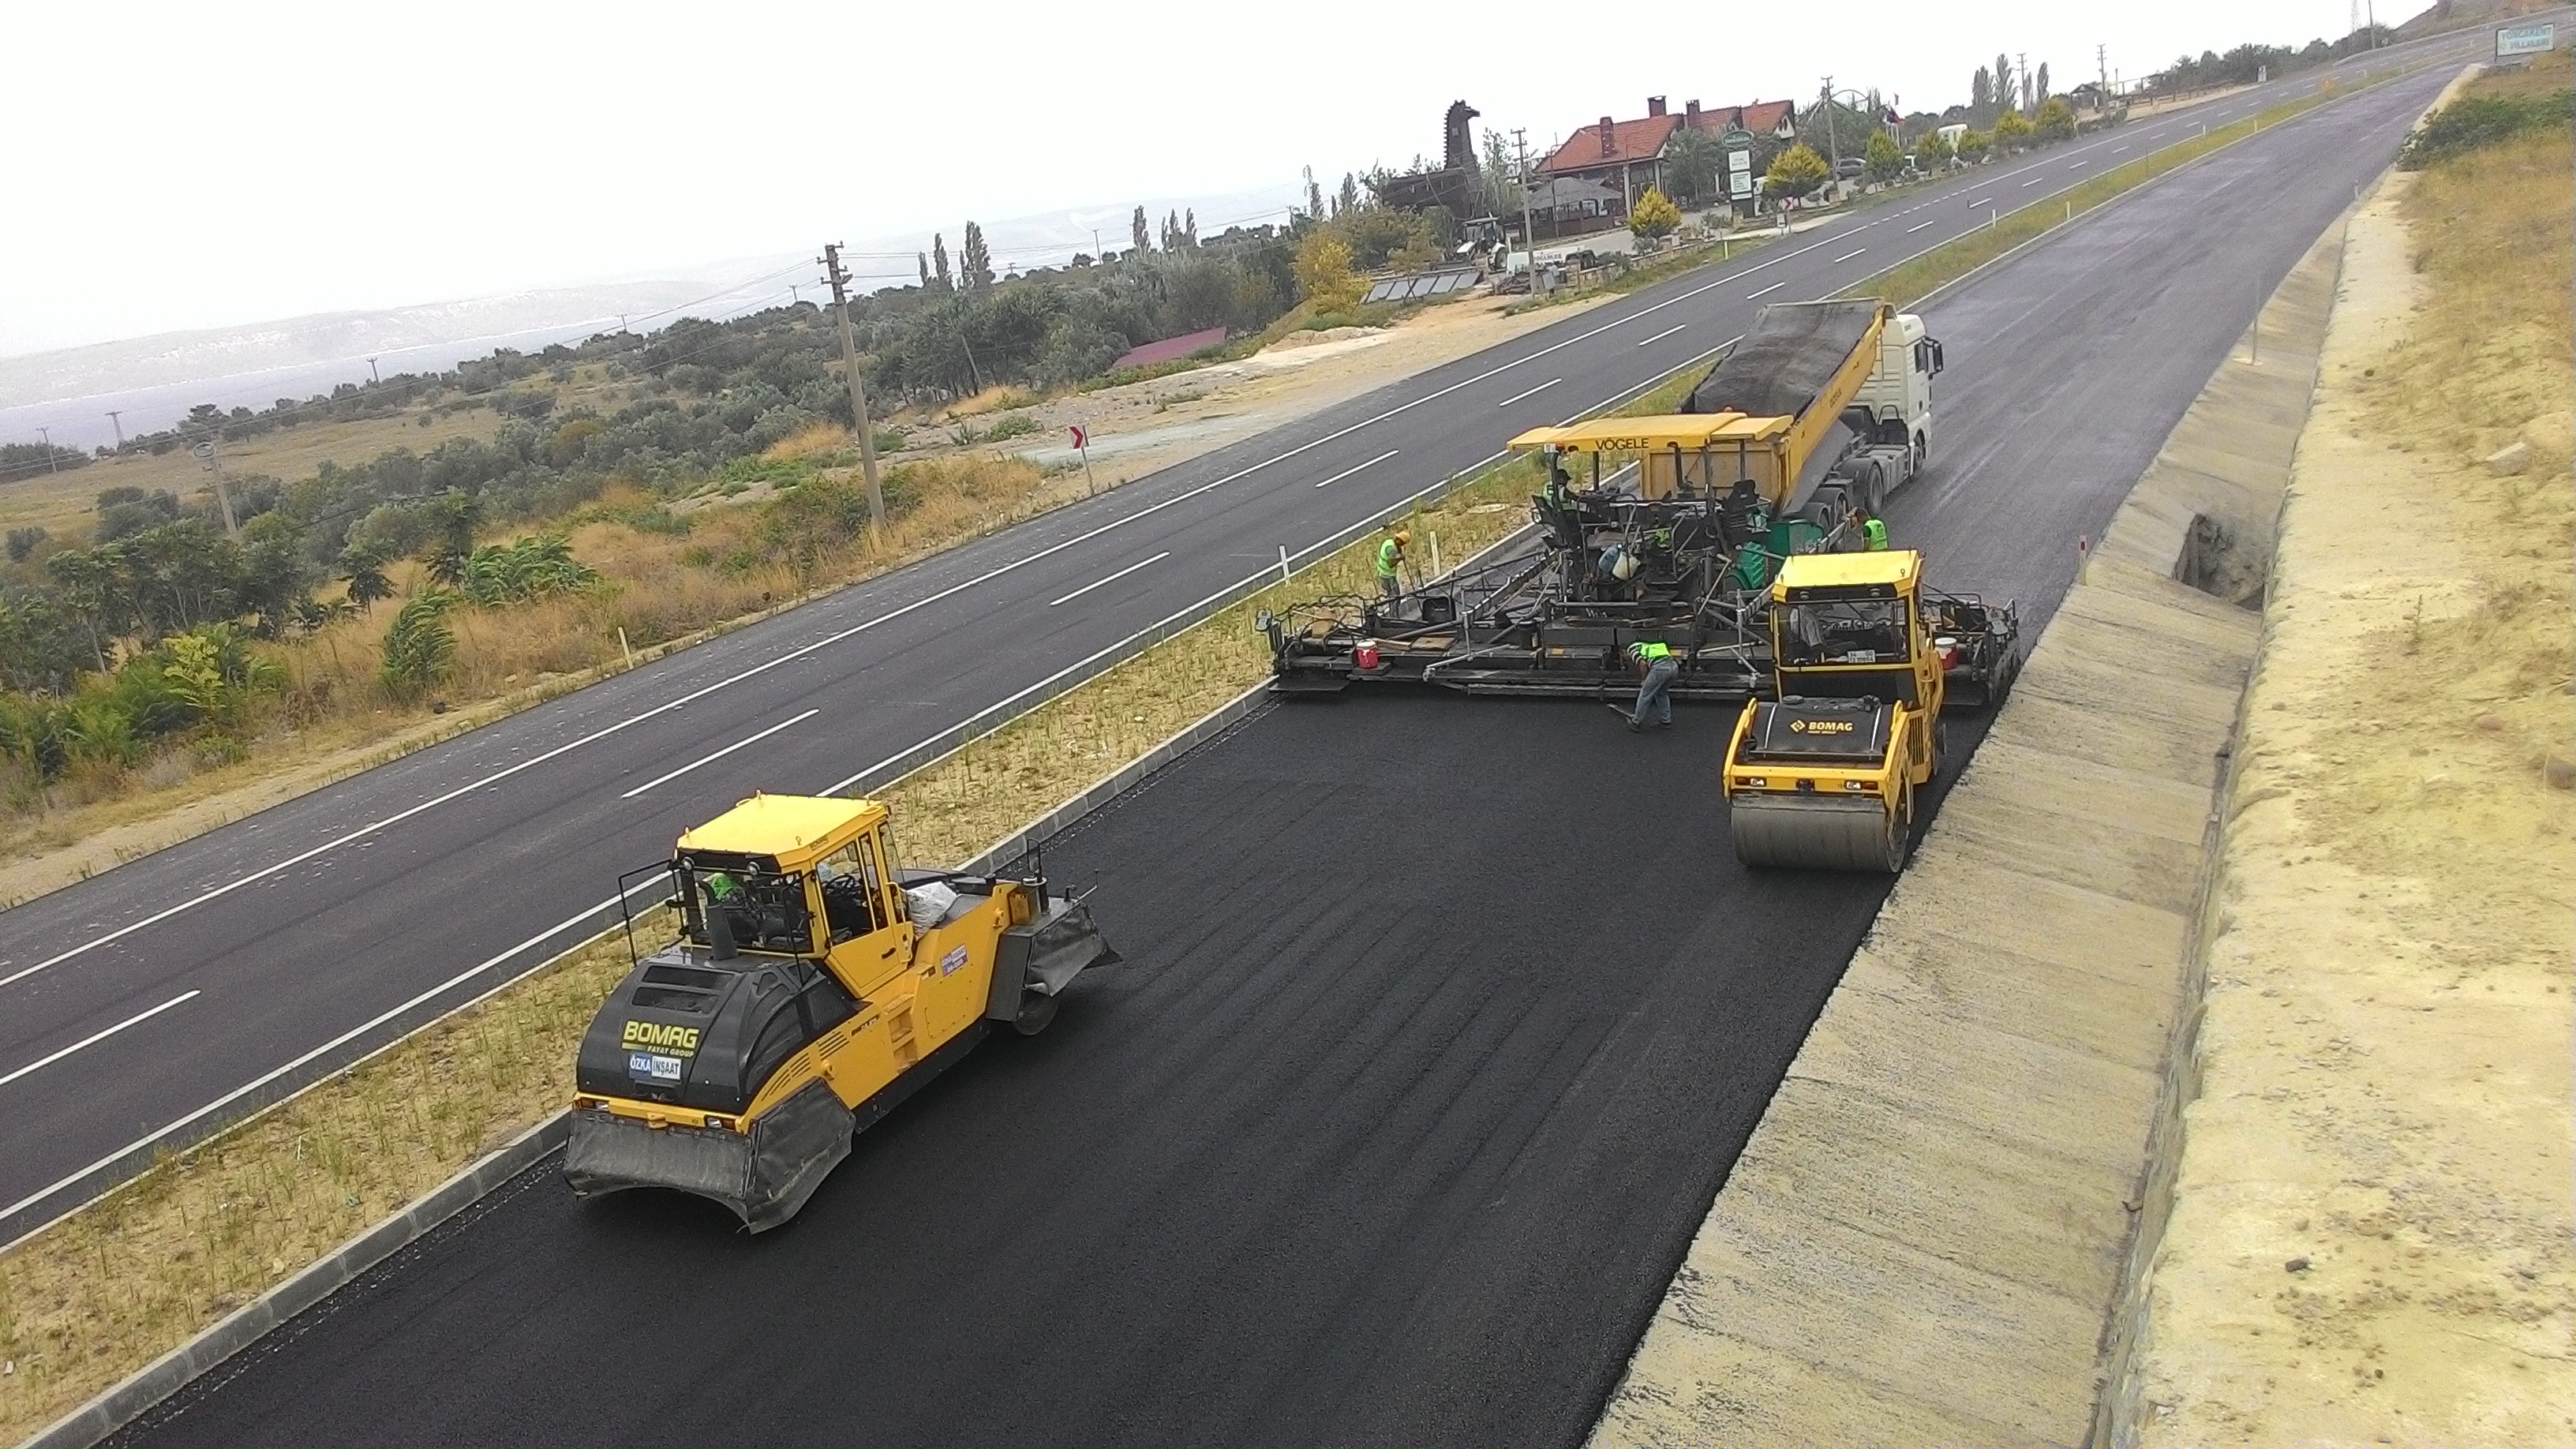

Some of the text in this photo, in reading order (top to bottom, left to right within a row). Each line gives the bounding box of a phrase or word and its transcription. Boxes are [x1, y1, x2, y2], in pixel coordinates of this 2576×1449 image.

[1595, 437, 1649, 450] VÖGELE
[1809, 721, 1853, 731] BOMAG
[623, 1020, 700, 1048] BOMAG
[670, 1049, 695, 1058] GROUP
[630, 1055, 651, 1072] ÖZKA
